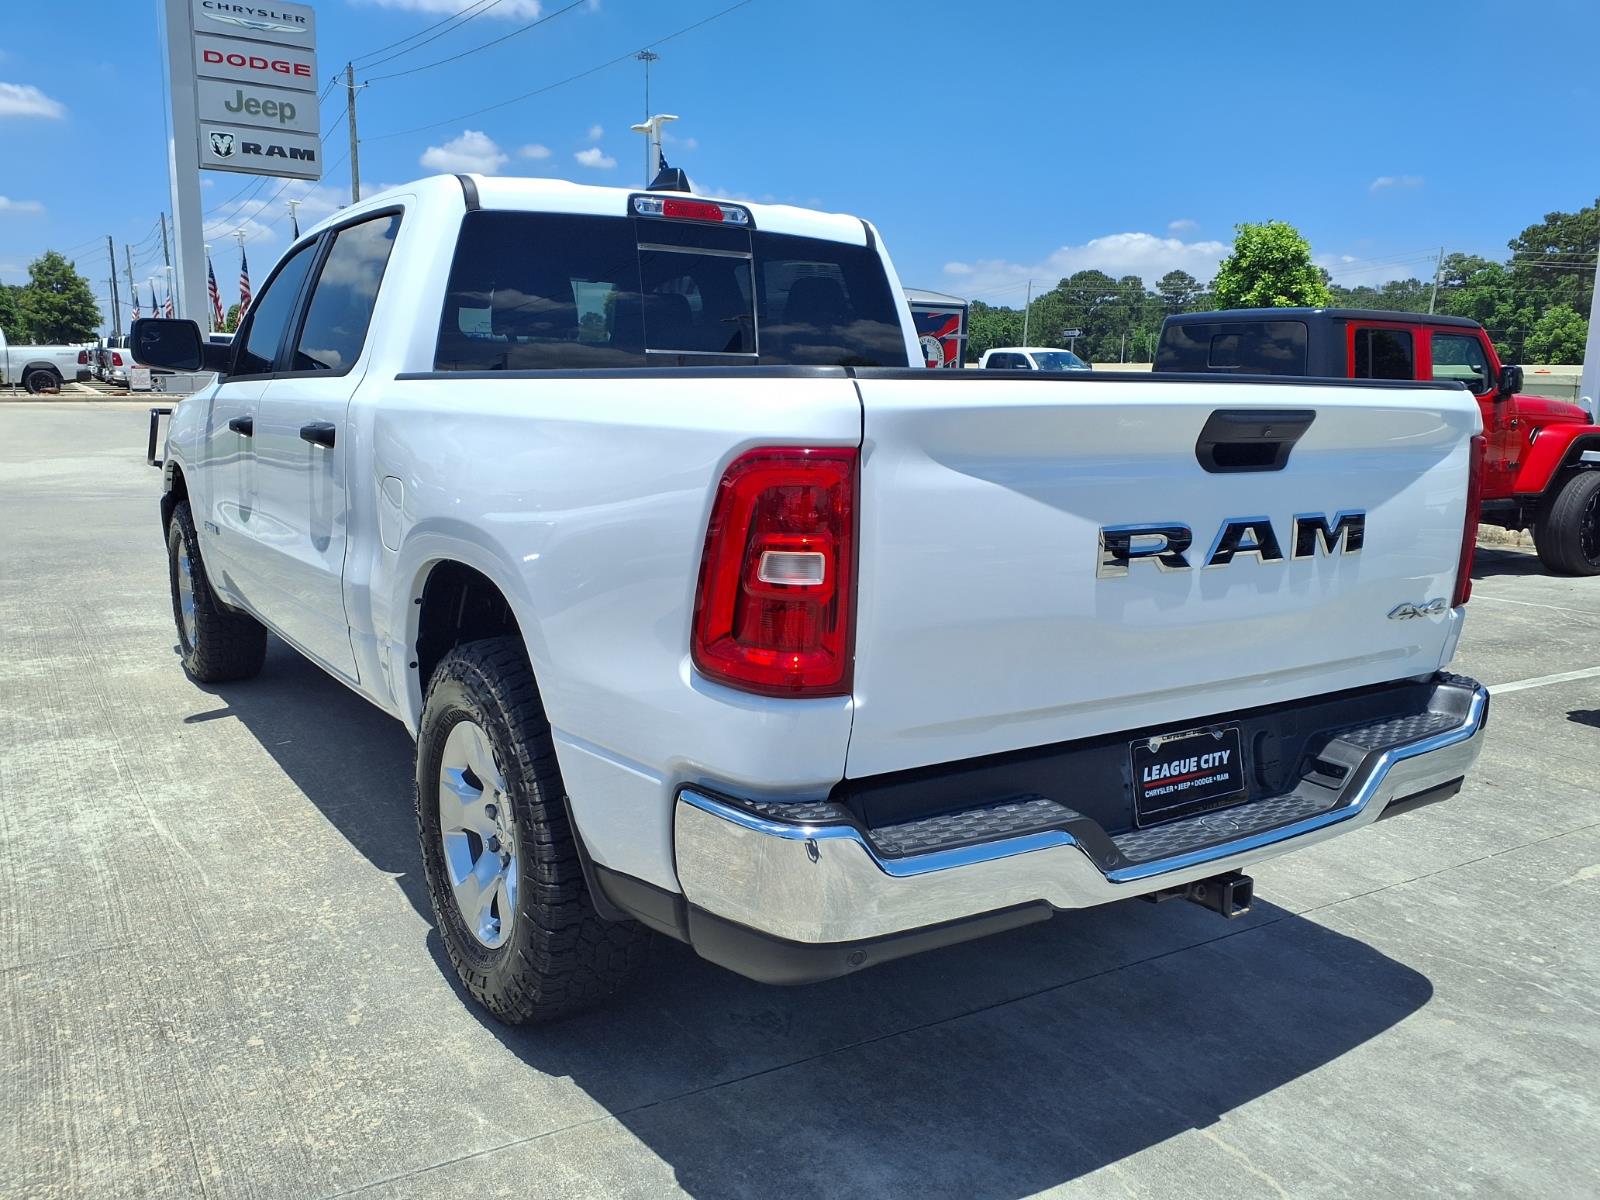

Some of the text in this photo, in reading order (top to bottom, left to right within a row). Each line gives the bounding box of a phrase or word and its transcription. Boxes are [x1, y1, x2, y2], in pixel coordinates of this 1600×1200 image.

[202, 1, 306, 23] CHRYSLER
[203, 50, 311, 77] DODGE
[224, 89, 297, 124] Jeep
[241, 141, 316, 162] RAM
[1096, 509, 1367, 579] RAM
[1143, 750, 1231, 782] LEAGUE CITY
[1145, 773, 1229, 798] CHRYSLER JEEP DODGE RAM
